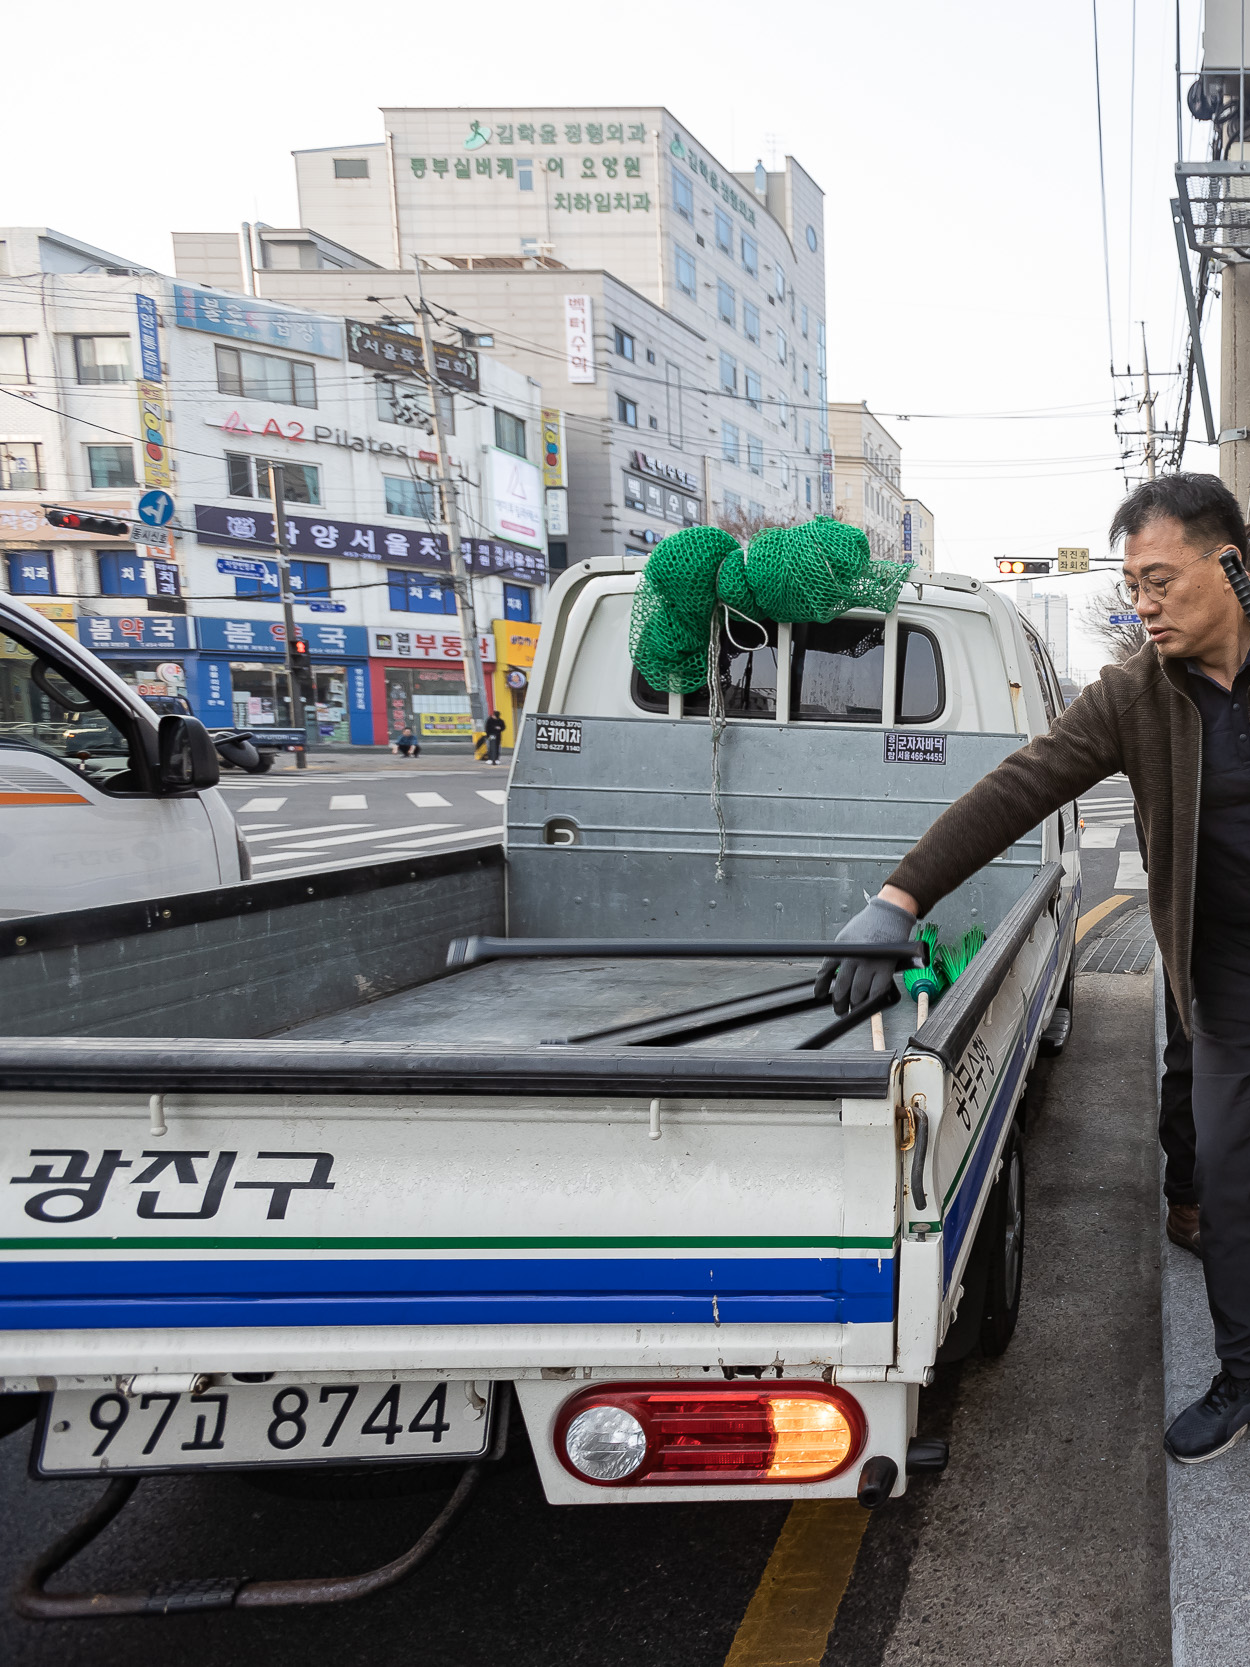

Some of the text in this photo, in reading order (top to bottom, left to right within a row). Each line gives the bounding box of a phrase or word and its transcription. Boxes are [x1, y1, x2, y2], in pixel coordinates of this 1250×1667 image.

[564, 122, 647, 145] 정형외과
[580, 156, 641, 178] 요양원
[262, 418, 305, 442] A2
[315, 425, 408, 456] Pilates
[131, 526, 169, 545] 동시신호
[1060, 550, 1087, 560] 직진후
[1060, 561, 1088, 571] 좌회전
[22, 566, 50, 581] 치과
[159, 571, 177, 597] 치과
[409, 586, 443, 601] 치과
[89, 618, 175, 642] 봄약국
[537, 726, 581, 743] 스카이차
[899, 736, 943, 751] 군자차바닥
[887, 735, 895, 760] 공구함
[9, 1147, 337, 1224] 광진구
[89, 1382, 450, 1457] 97고 8744
